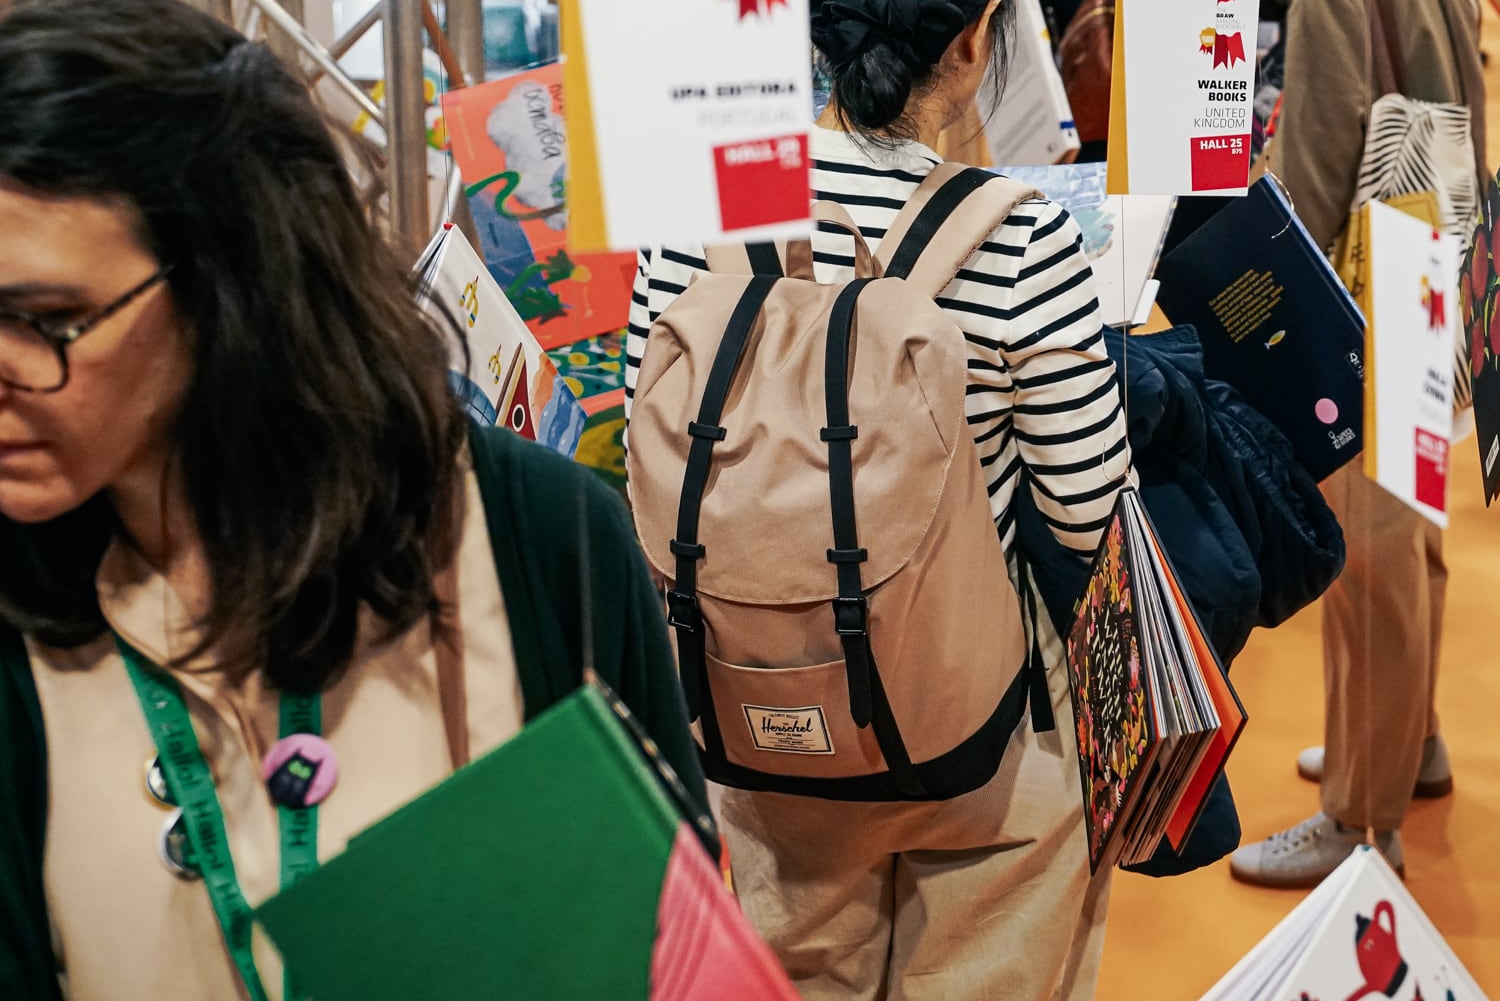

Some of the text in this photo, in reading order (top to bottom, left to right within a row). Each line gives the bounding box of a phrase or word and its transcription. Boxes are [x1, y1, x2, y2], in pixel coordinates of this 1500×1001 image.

[1197, 79, 1247, 90] WALKER
[1208, 92, 1247, 102] BOOKS
[1205, 107, 1246, 119] UNITED
[1194, 117, 1245, 129] KINGDOM
[1200, 137, 1243, 150] HALL 25
[1231, 147, 1243, 155] B75
[1111, 623, 1124, 682] THE
[1101, 606, 1123, 722] WITCH
[1098, 639, 1115, 723] IN THE
[1090, 624, 1112, 760] TOWER
[760, 716, 813, 734] Herschel
